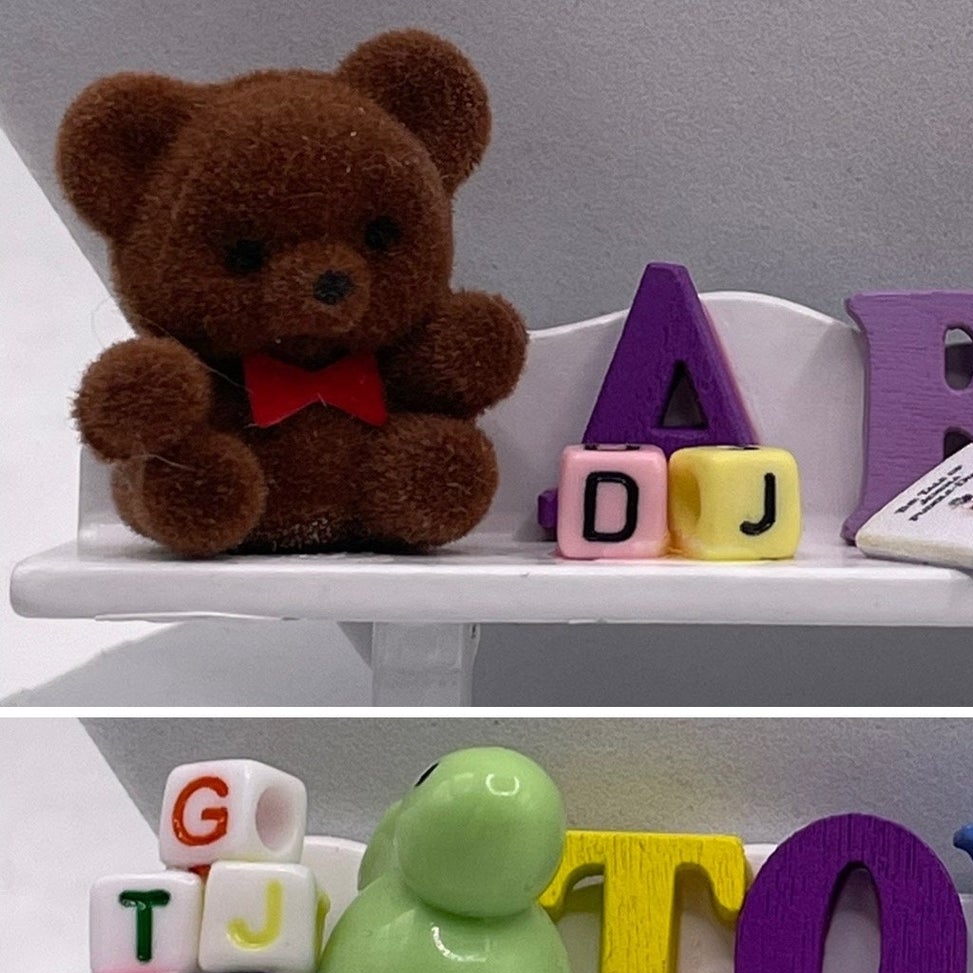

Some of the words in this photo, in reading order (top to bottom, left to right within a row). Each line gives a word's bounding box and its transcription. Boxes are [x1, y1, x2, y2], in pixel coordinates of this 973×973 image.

[581, 471, 641, 543] D
[739, 471, 777, 537] J
[172, 775, 230, 847] G
[118, 889, 172, 963] T
[226, 878, 284, 950] J
